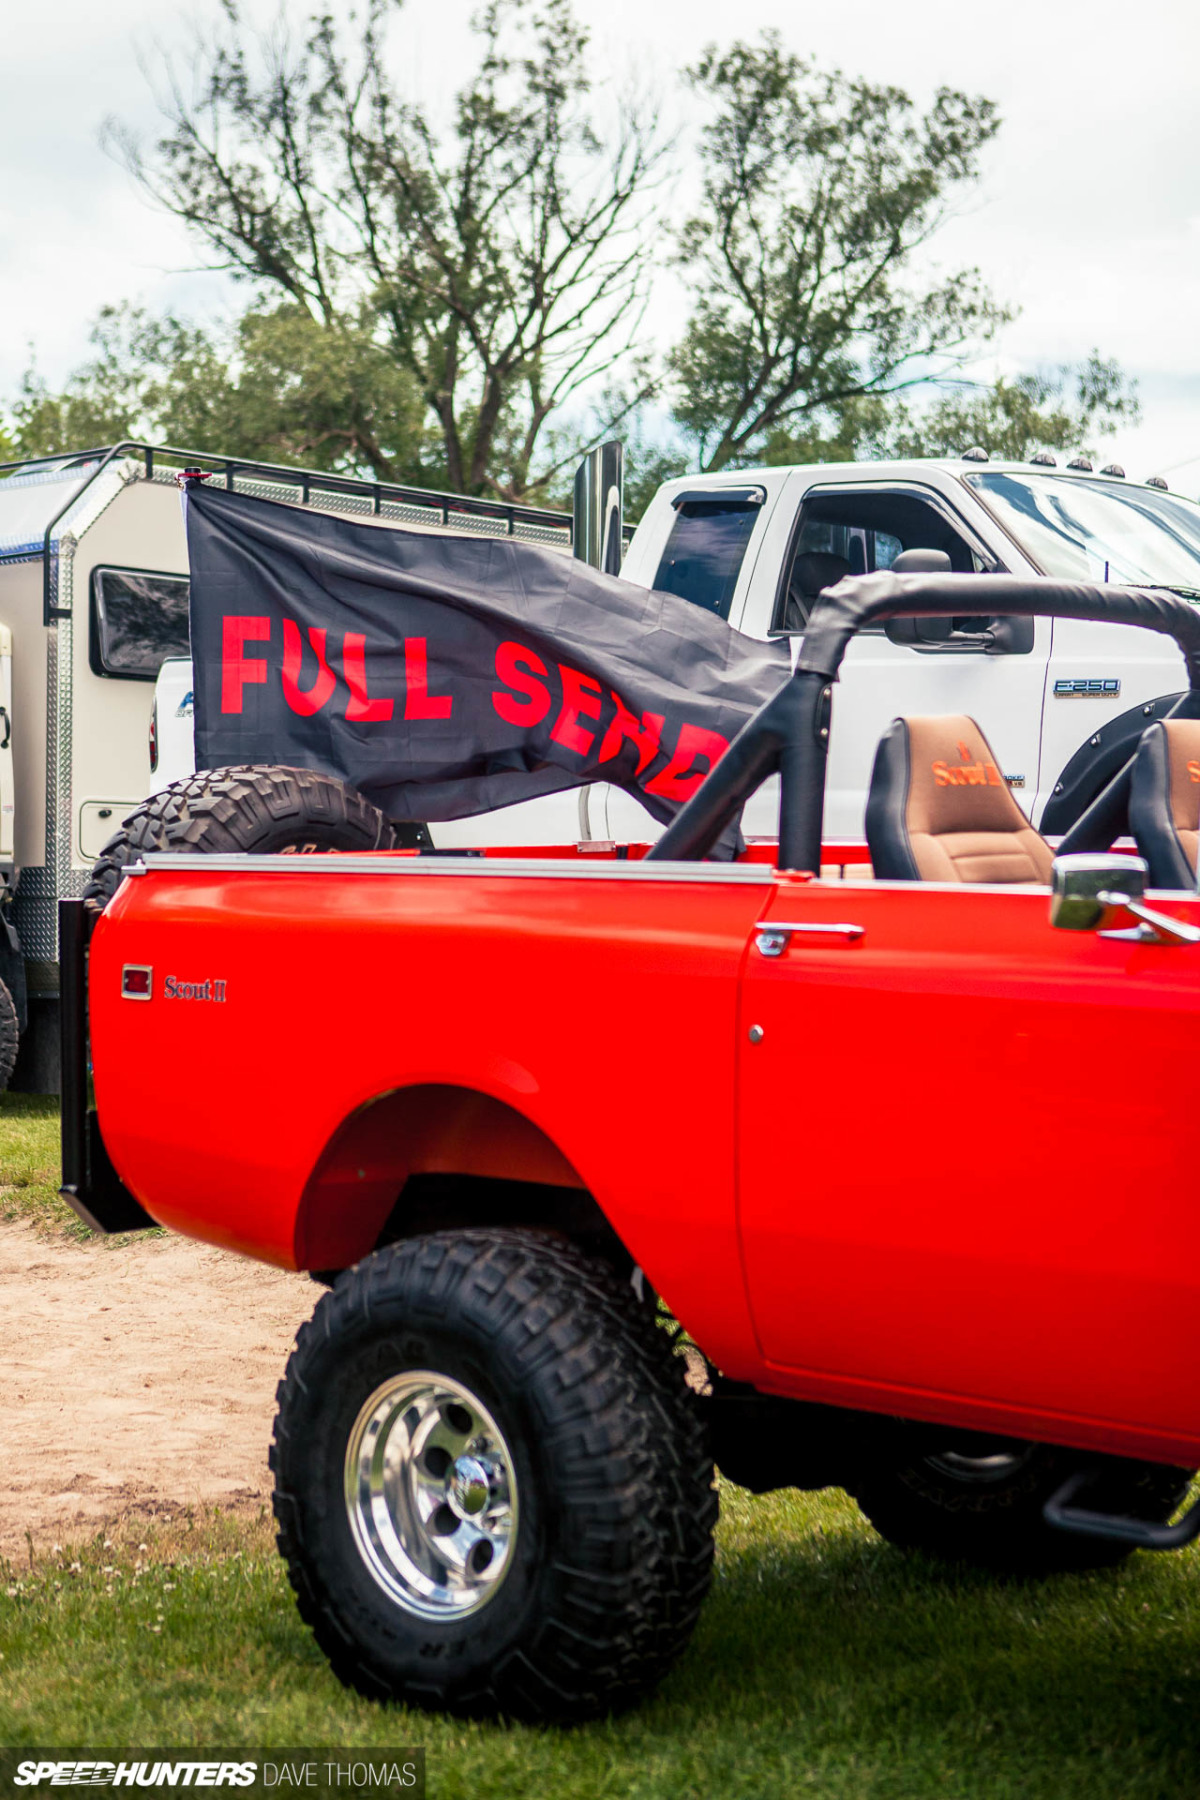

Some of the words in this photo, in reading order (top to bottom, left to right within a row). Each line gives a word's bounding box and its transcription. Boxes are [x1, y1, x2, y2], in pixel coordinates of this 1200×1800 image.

[221, 616, 453, 722] FULL
[491, 641, 732, 803] SEND
[164, 975, 211, 1000] Scout
[213, 979, 227, 1002] II
